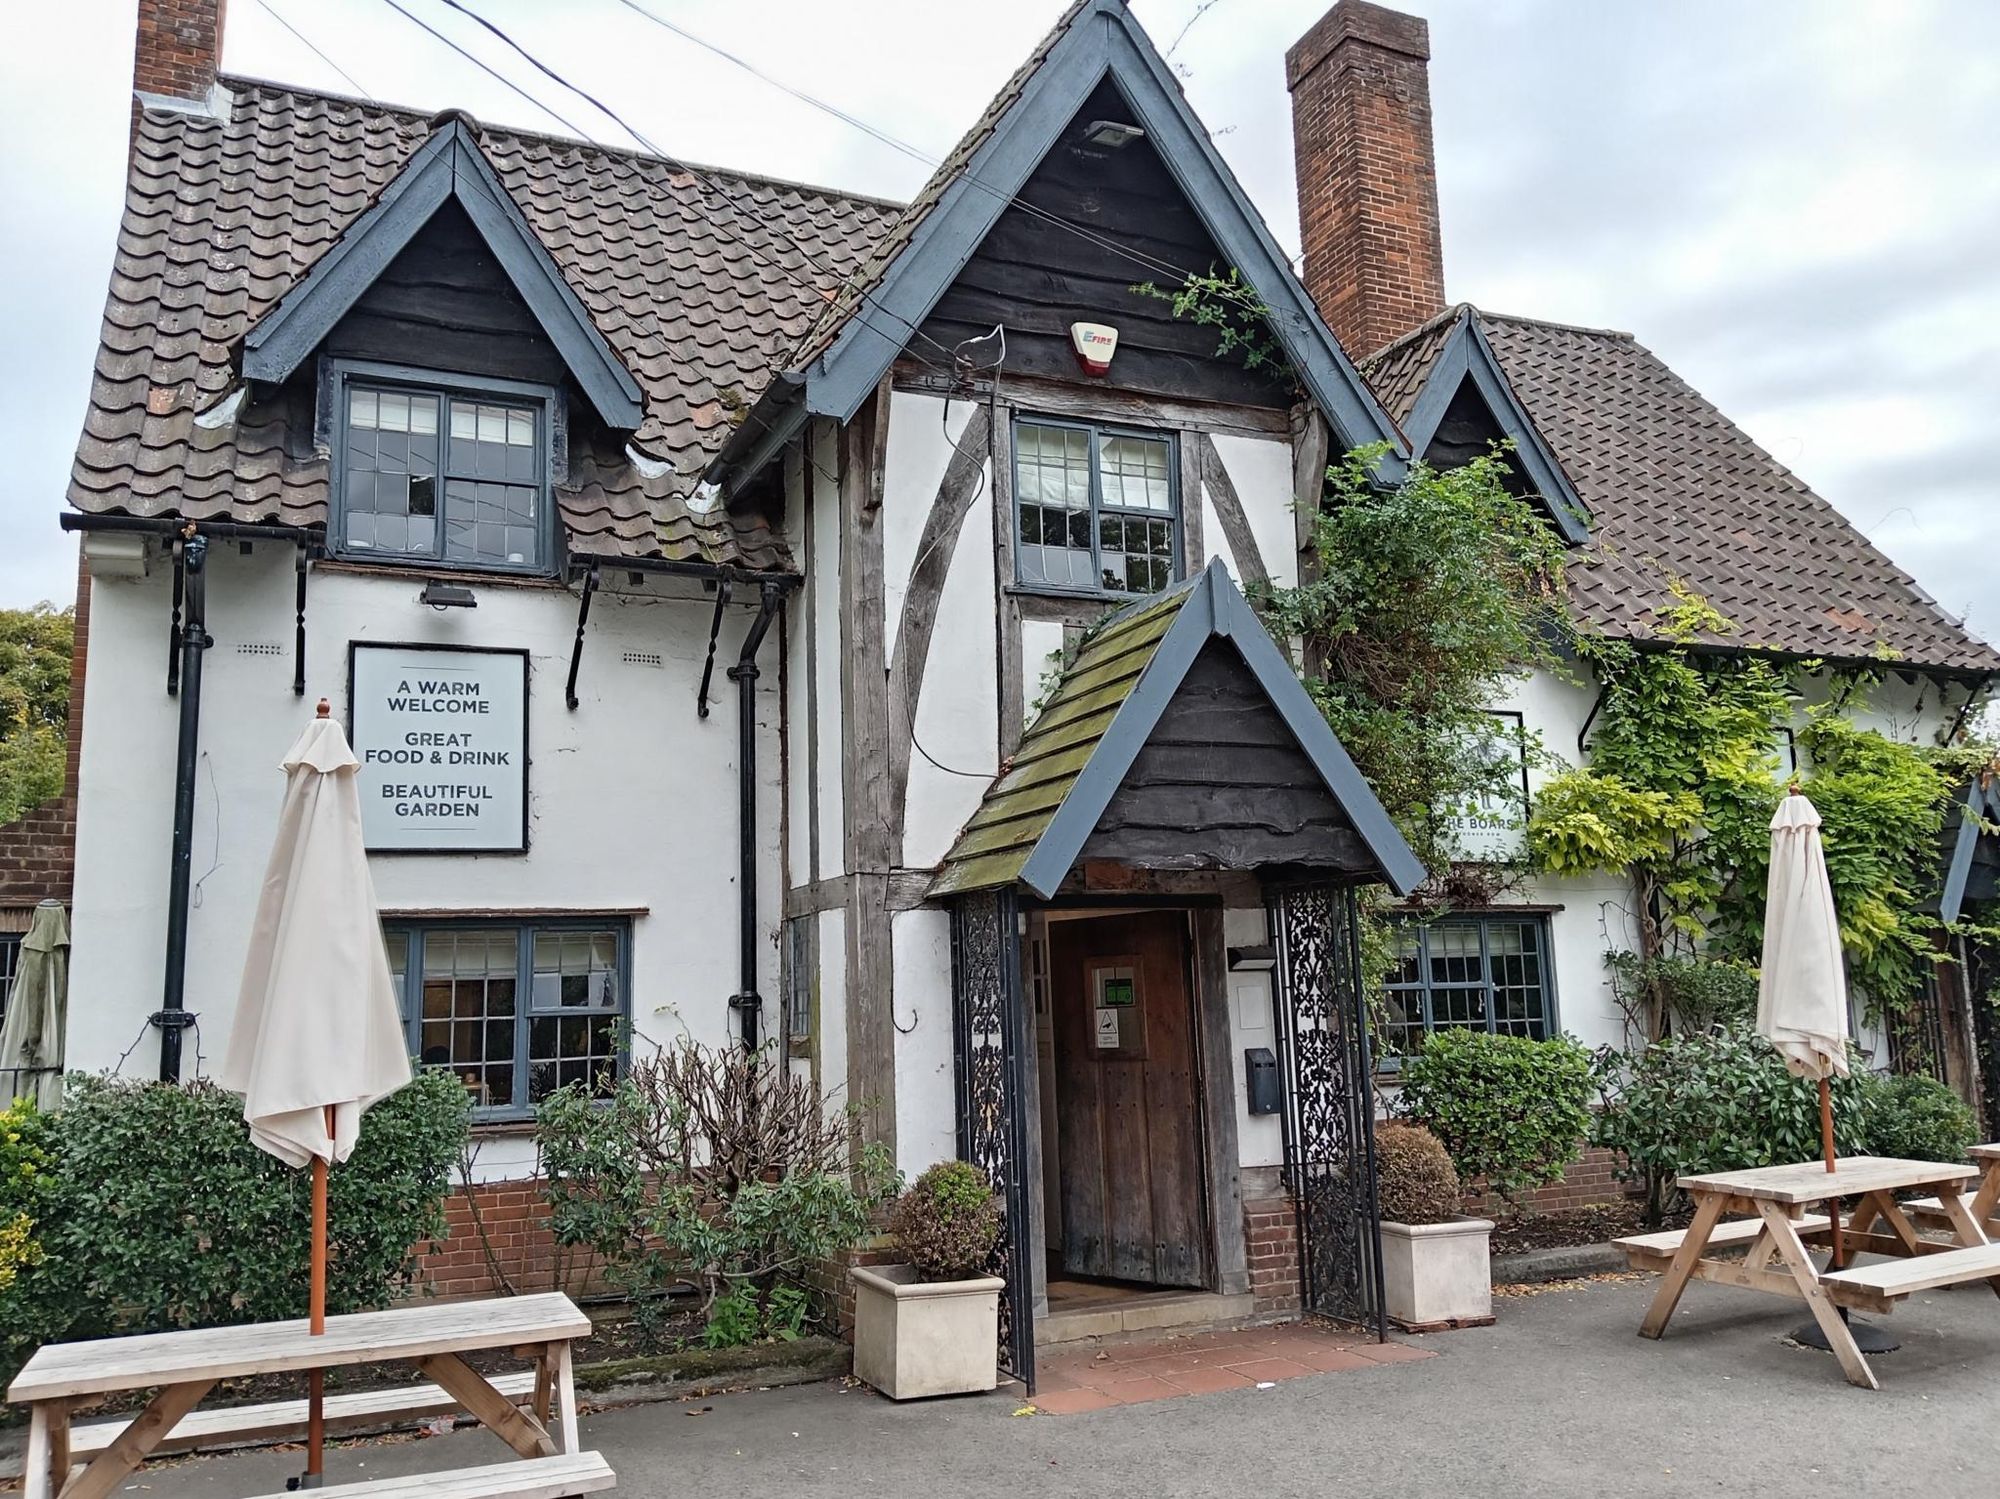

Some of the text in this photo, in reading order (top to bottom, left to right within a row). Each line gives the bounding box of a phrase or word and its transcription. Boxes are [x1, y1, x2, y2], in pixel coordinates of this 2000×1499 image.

[397, 680, 480, 696] A WARM
[387, 698, 490, 714] WELCOME
[405, 732, 472, 747] GREAT
[365, 749, 510, 765] FOOD & DRINK
[382, 784, 493, 799] BEAUTIFUL
[395, 802, 480, 817] GARDEN
[1447, 818, 1464, 829] HE
